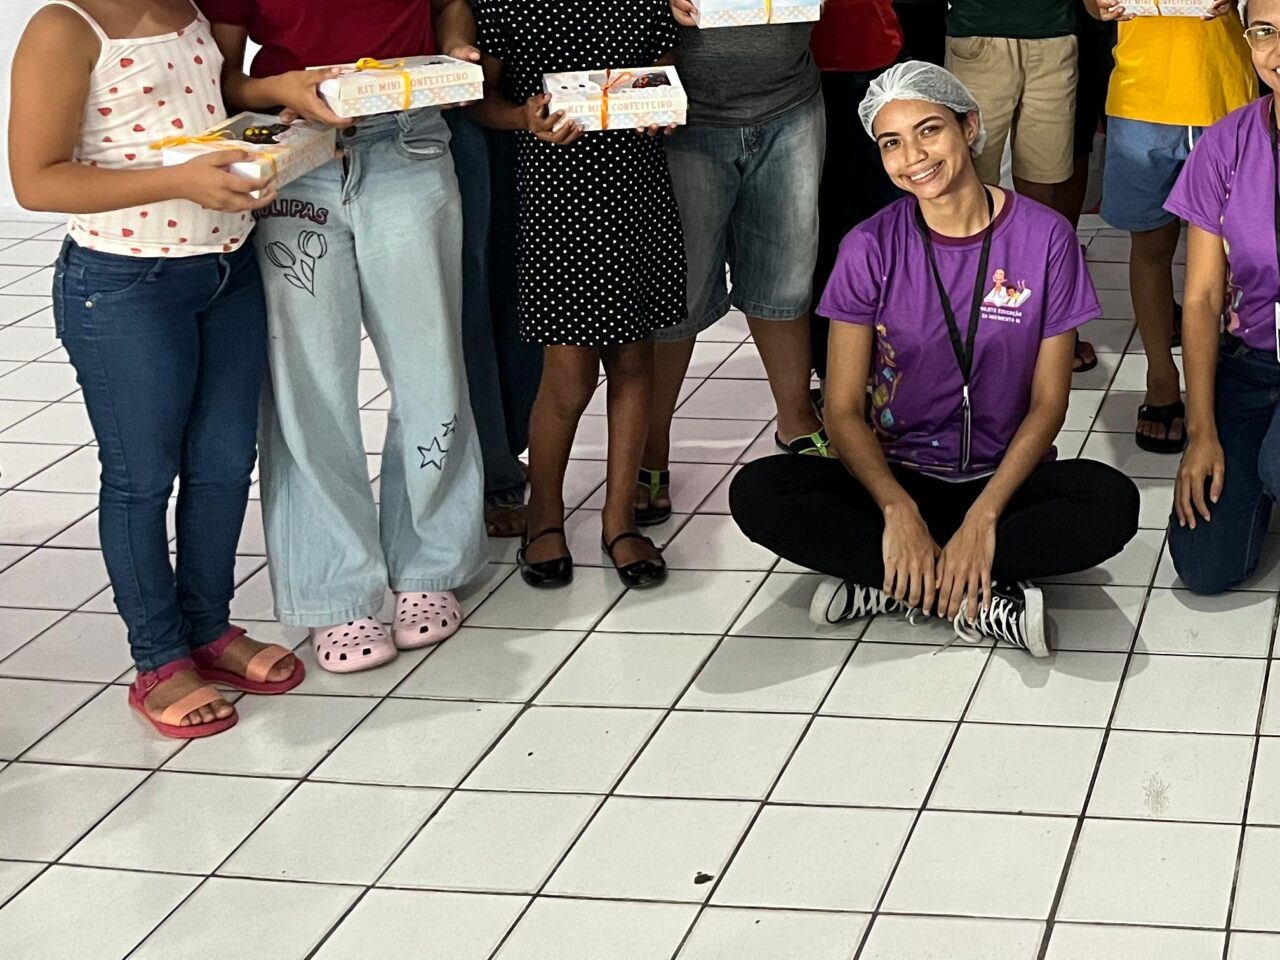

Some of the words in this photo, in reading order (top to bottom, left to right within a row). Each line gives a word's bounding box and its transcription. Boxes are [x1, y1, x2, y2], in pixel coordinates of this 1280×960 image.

[357, 84, 376, 95] KIT
[411, 72, 469, 87] ONFEITEIRO
[568, 105, 585, 114] KIT
[611, 100, 673, 112] CONFEITEIRO
